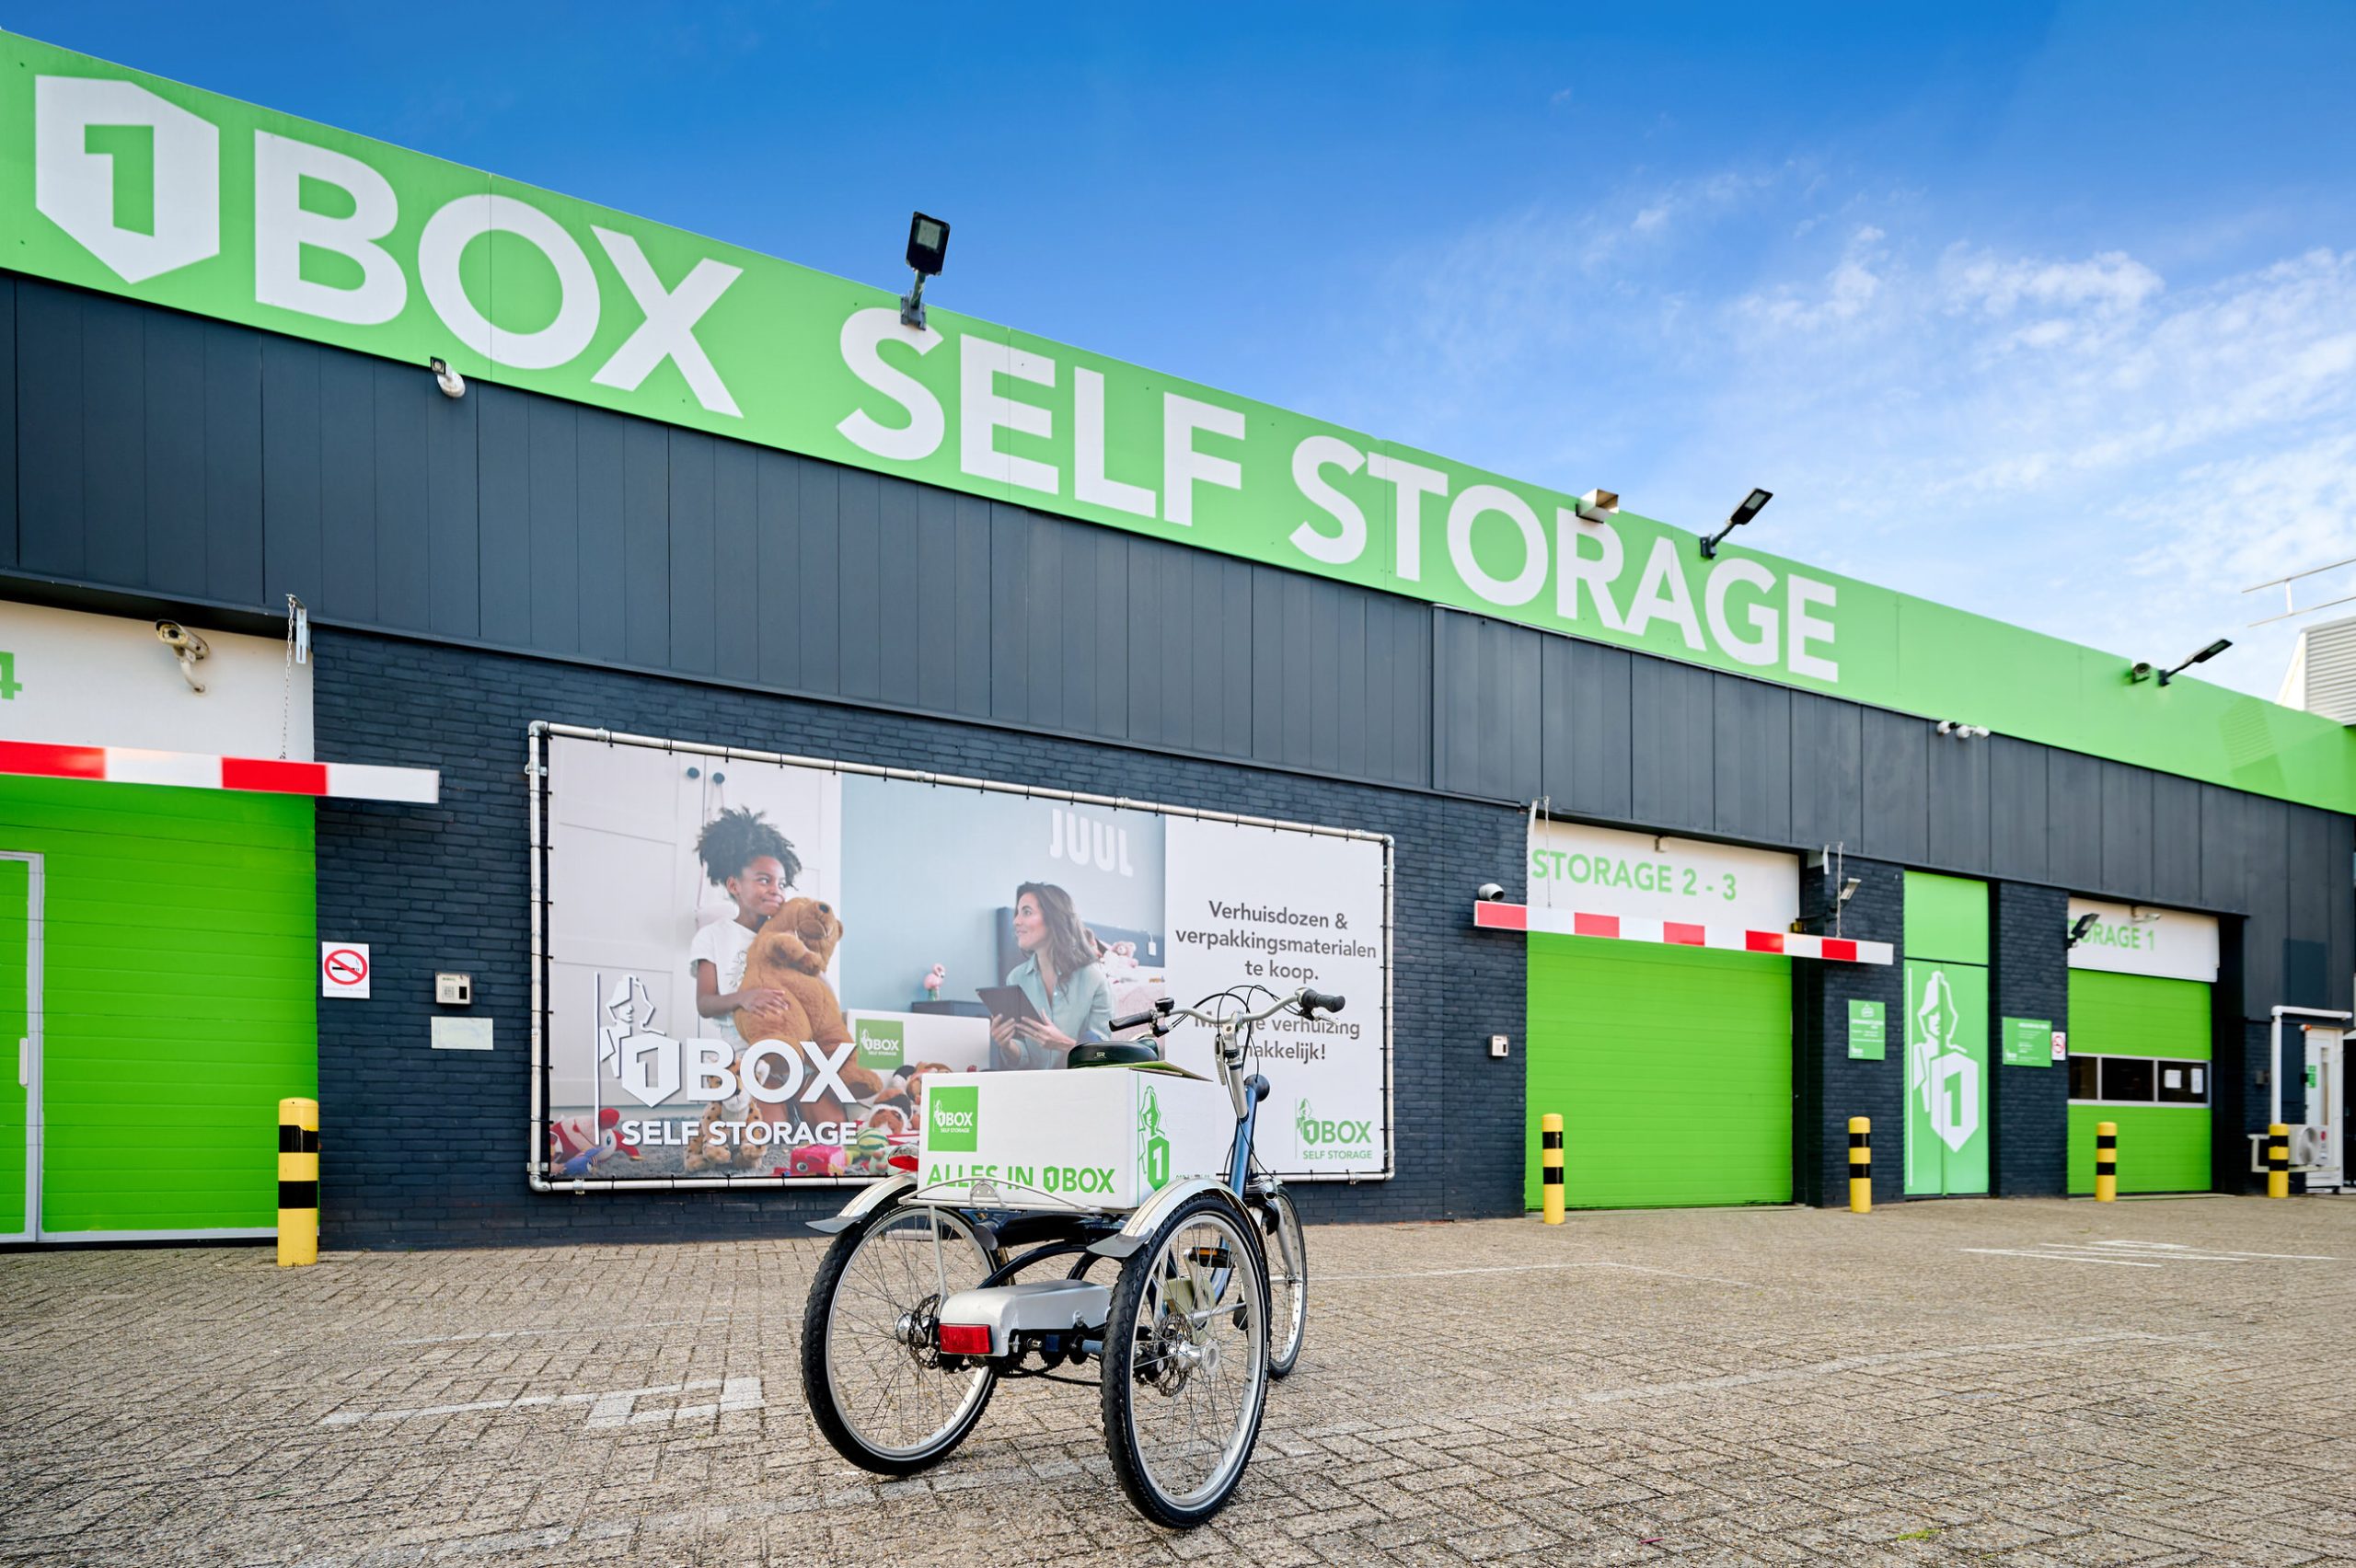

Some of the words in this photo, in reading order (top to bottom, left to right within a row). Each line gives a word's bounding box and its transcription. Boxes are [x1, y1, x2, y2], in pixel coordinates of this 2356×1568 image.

[836, 307, 1245, 526] SELF
[1289, 435, 1839, 683] STORAGE
[1050, 809, 1133, 877] JUUL
[1531, 848, 1672, 894] STORAGE
[1682, 868, 1697, 896] 2
[1723, 874, 1737, 900] 3
[1208, 900, 1329, 928] Verhuisdozen
[1334, 913, 1348, 929] &
[1175, 928, 1377, 959] verpakkingsmaterialen
[2146, 929, 2154, 951] 1
[1245, 960, 1264, 976] te
[1269, 960, 1319, 984] koop.
[1272, 1016, 1360, 1040] verhuizing
[621, 1121, 699, 1145] SELF
[709, 1121, 858, 1146] STORAGE
[1302, 1150, 1325, 1159] SELF
[1328, 1150, 1372, 1159] STORAGE
[927, 1163, 999, 1188] ALLES
[1008, 1166, 1033, 1189] IN
